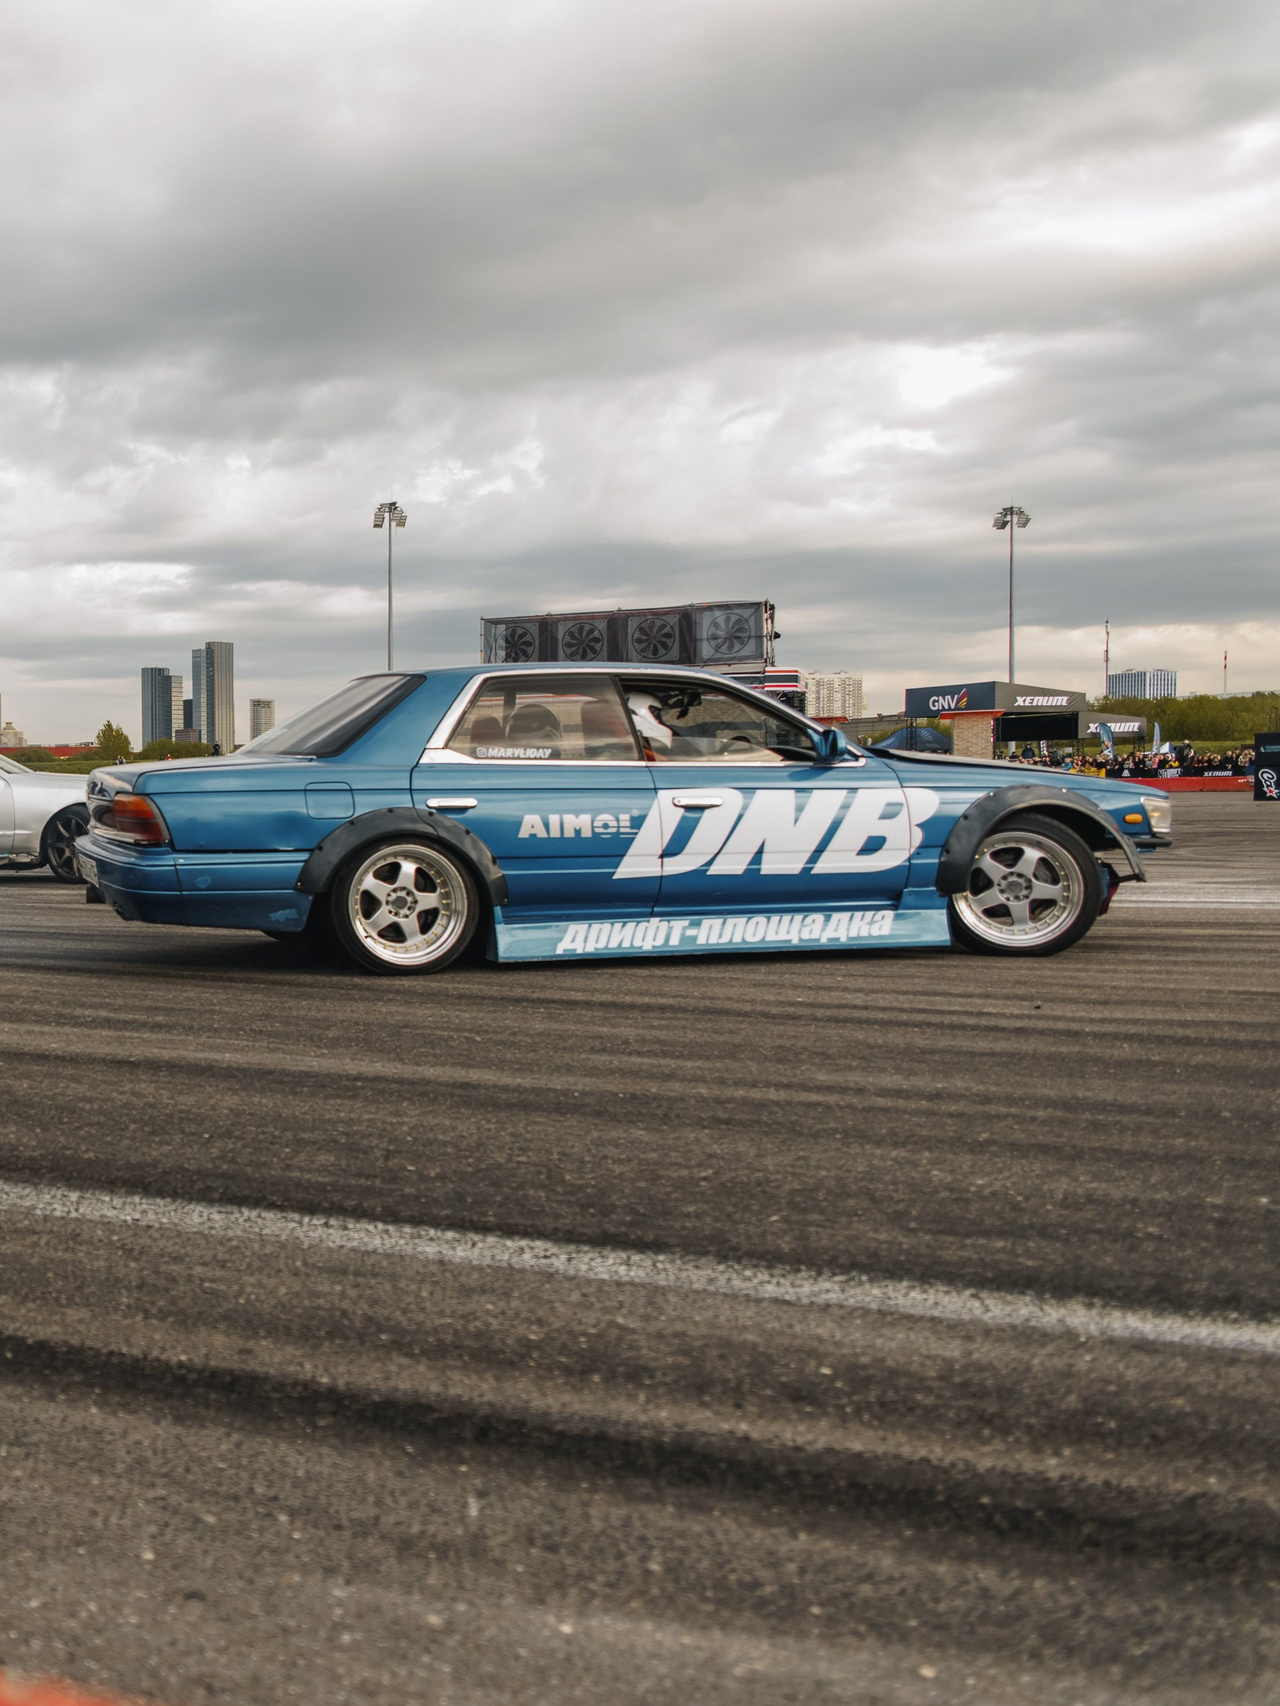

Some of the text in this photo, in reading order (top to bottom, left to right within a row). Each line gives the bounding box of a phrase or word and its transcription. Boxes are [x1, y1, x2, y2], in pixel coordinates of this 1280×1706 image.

[929, 694, 958, 711] GNV
[1014, 696, 1069, 706] XENUM
[518, 813, 639, 838] AIMOL
[612, 787, 940, 879] DNB
[556, 910, 895, 954] дрифт-площадка
